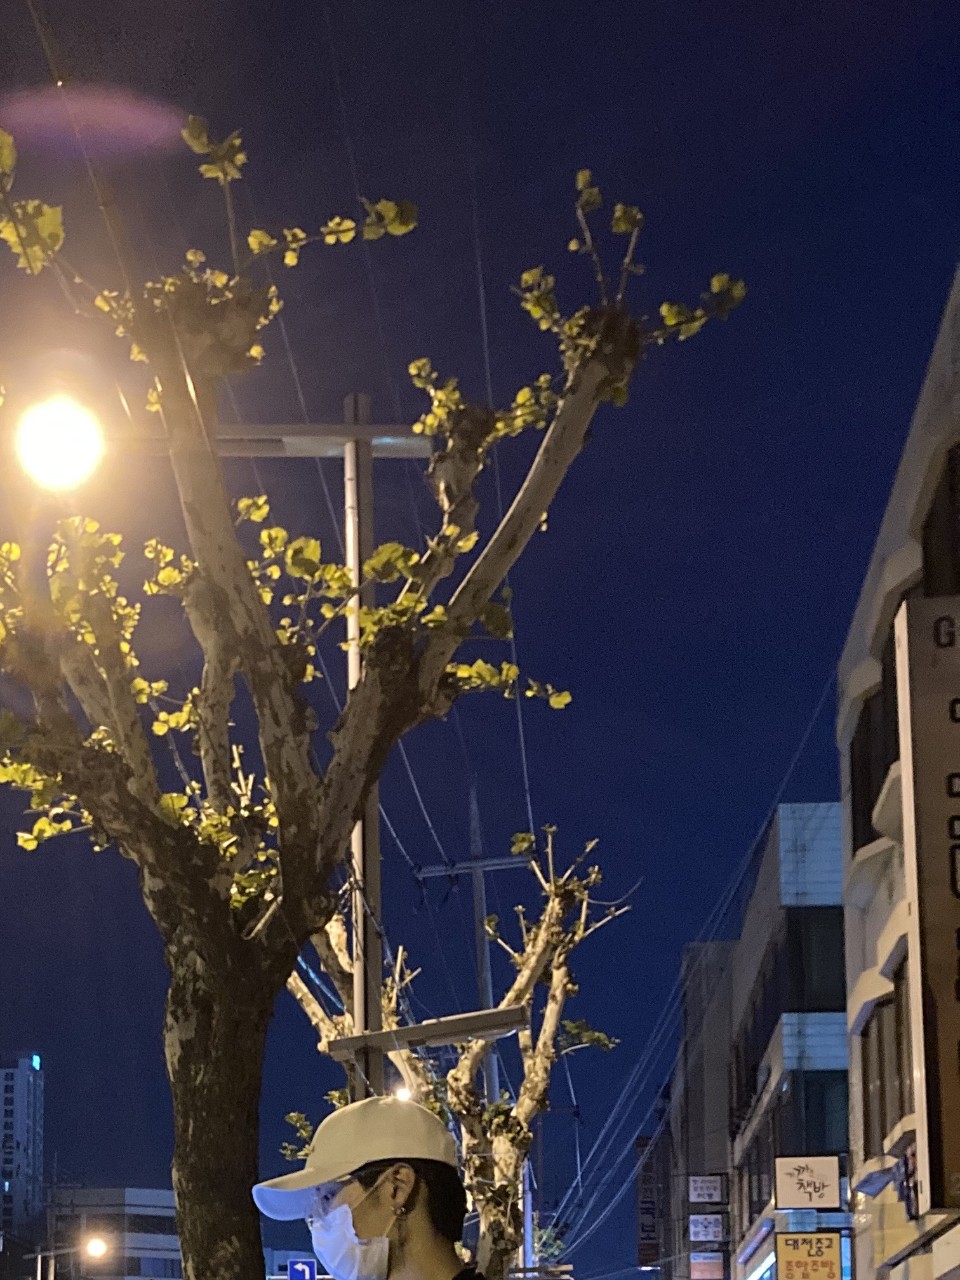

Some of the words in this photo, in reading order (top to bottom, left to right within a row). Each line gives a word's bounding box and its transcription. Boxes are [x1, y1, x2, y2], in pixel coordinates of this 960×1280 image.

[796, 1179, 831, 1202] 책방
[785, 1238, 834, 1257] 대전중고
[785, 1260, 836, 1279] 종합주방
